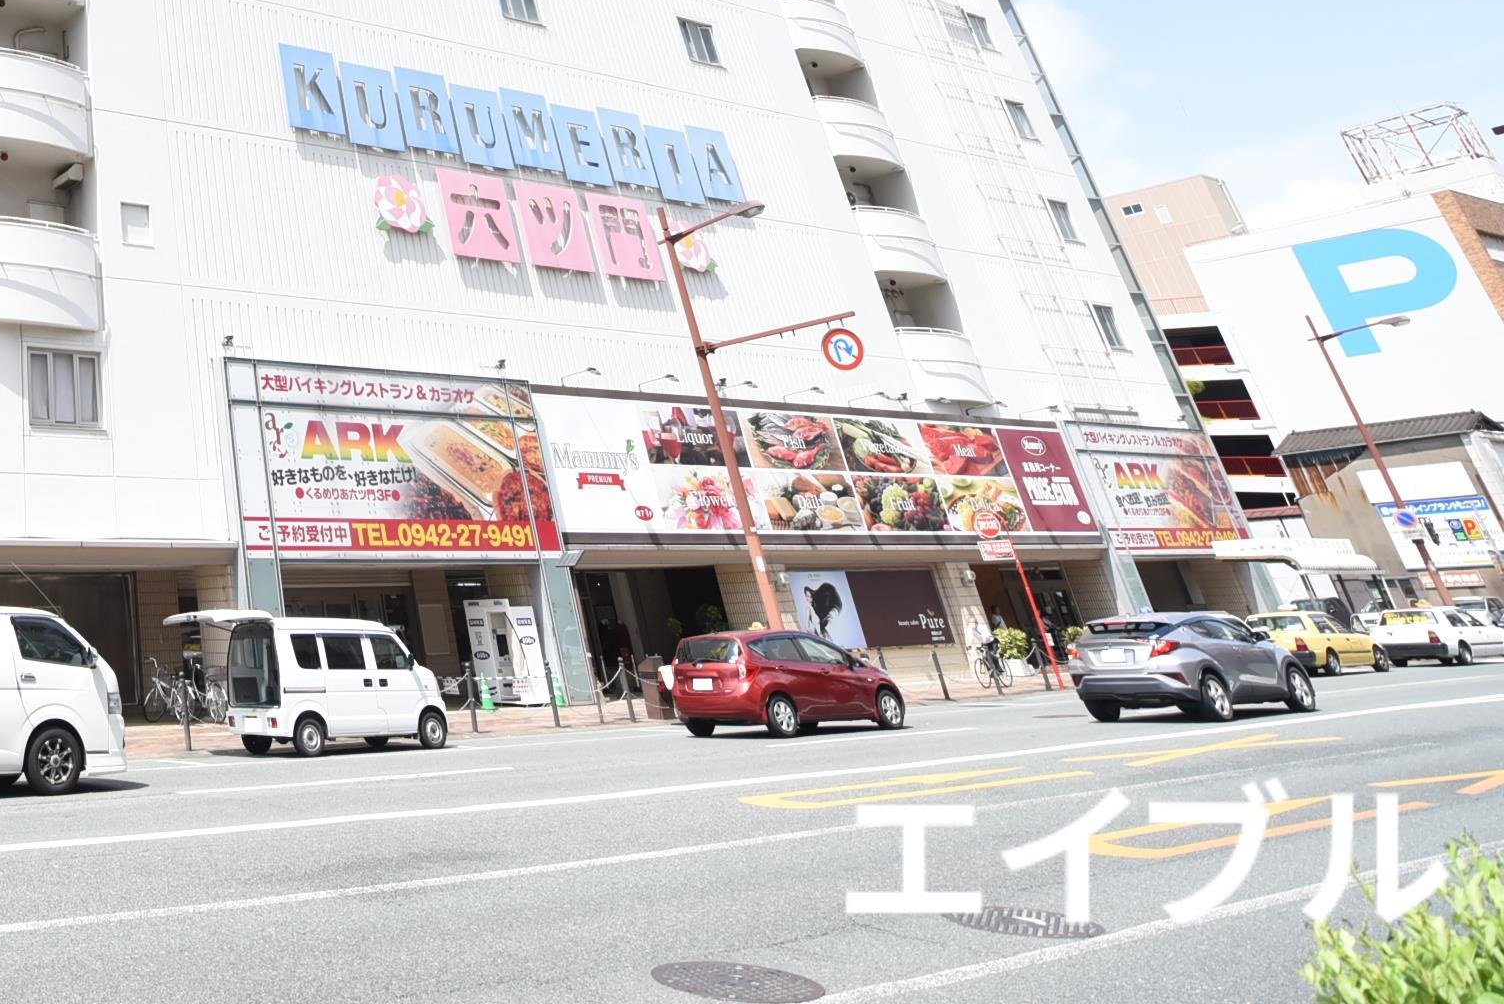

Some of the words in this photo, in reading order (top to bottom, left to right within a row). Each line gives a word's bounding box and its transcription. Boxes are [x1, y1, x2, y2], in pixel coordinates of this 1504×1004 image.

[291, 62, 734, 187] KURUMERIA
[449, 183, 652, 270] 六ツ門
[1292, 228, 1458, 357] P
[300, 419, 413, 463] ARK
[675, 429, 715, 446] Liquor
[779, 434, 807, 449] Fish
[861, 439, 912, 456] Vegeta
[953, 443, 978, 459] Meat
[585, 473, 614, 485] PREMIUM
[1113, 461, 1169, 490] ARK
[889, 497, 917, 511] Fruit
[258, 524, 347, 544] ご予約受付中
[351, 522, 534, 547] TEL.0942-27-9491
[918, 613, 946, 630] Pure
